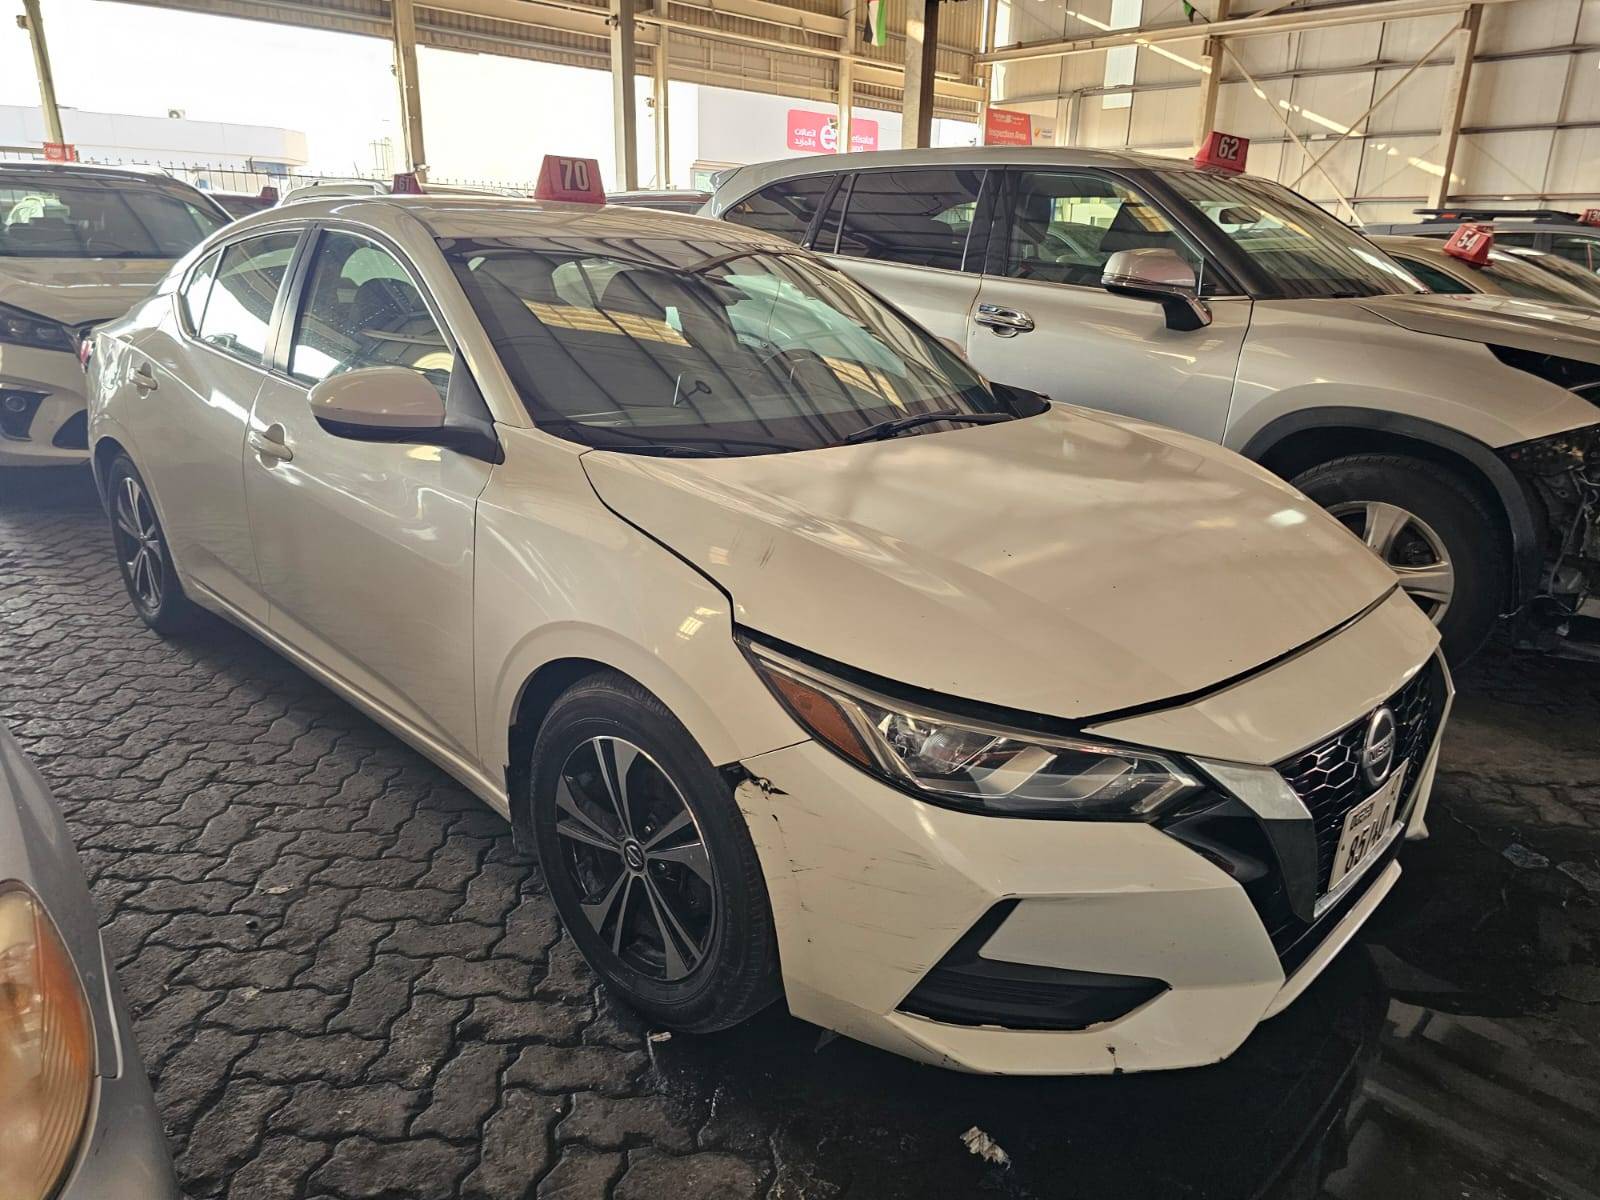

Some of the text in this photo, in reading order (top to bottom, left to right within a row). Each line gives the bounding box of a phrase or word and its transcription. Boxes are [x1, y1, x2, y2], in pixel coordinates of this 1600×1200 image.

[1218, 136, 1240, 160] 62
[559, 159, 590, 191] 70
[1456, 229, 1481, 251] 54
